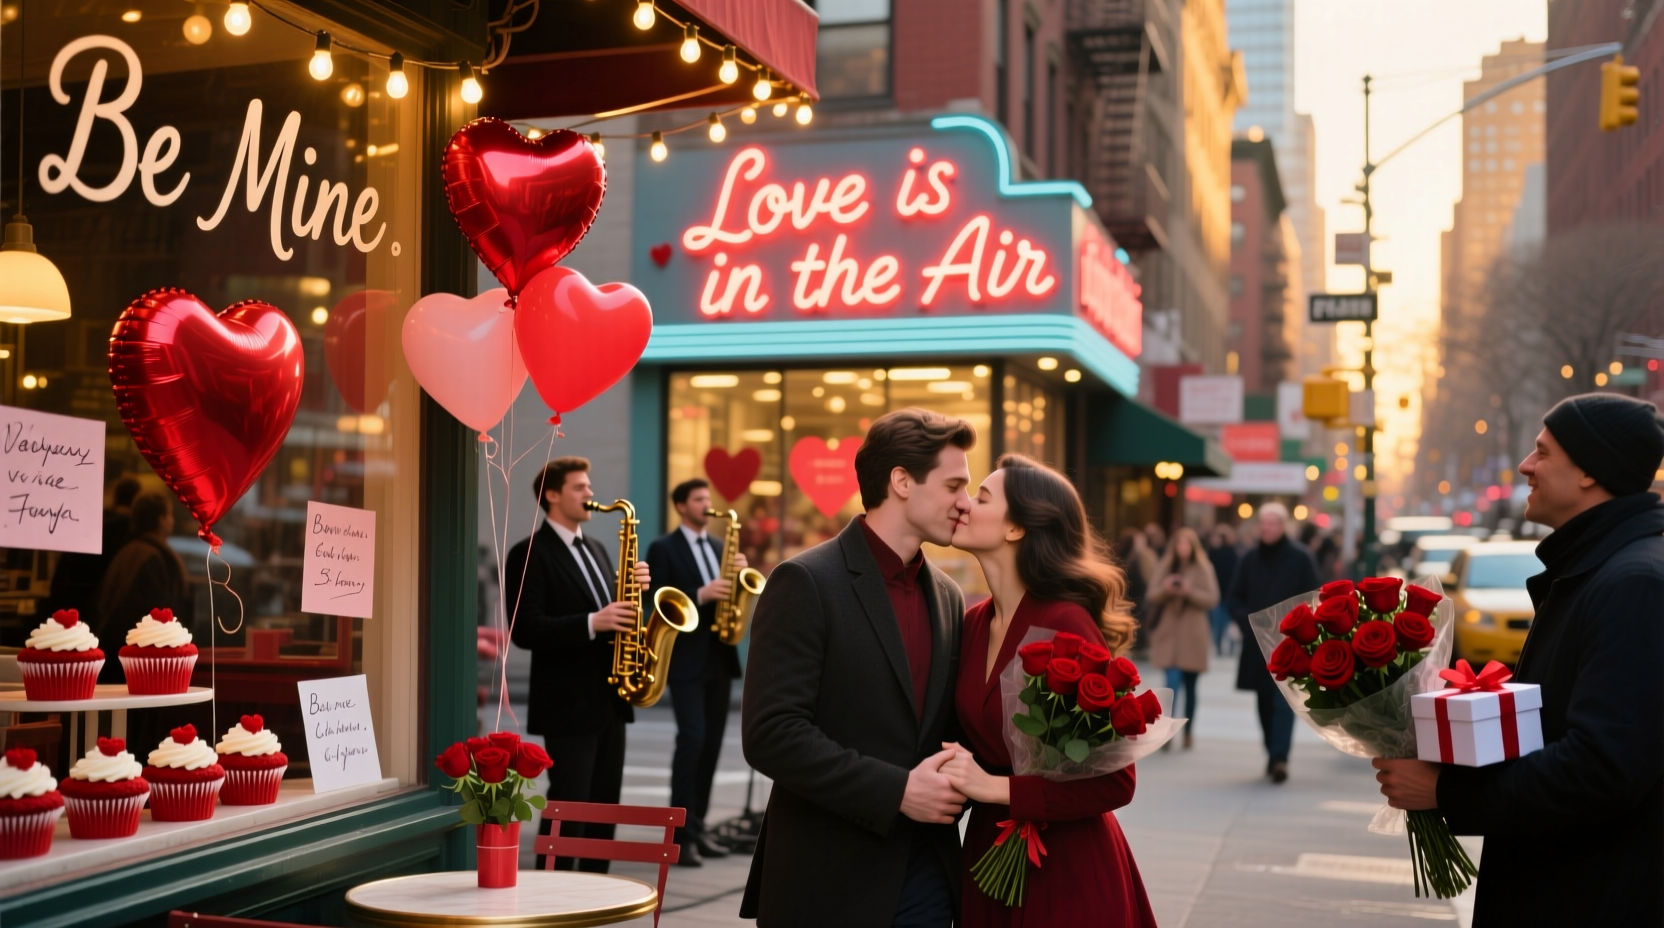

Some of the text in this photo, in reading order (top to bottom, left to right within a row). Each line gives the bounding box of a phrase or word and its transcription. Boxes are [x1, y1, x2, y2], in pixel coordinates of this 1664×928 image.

[38, 35, 402, 262] Be Mine.
[682, 147, 955, 251] Love is
[699, 252, 770, 315] in
[790, 233, 901, 311] the
[920, 215, 1056, 306] Air
